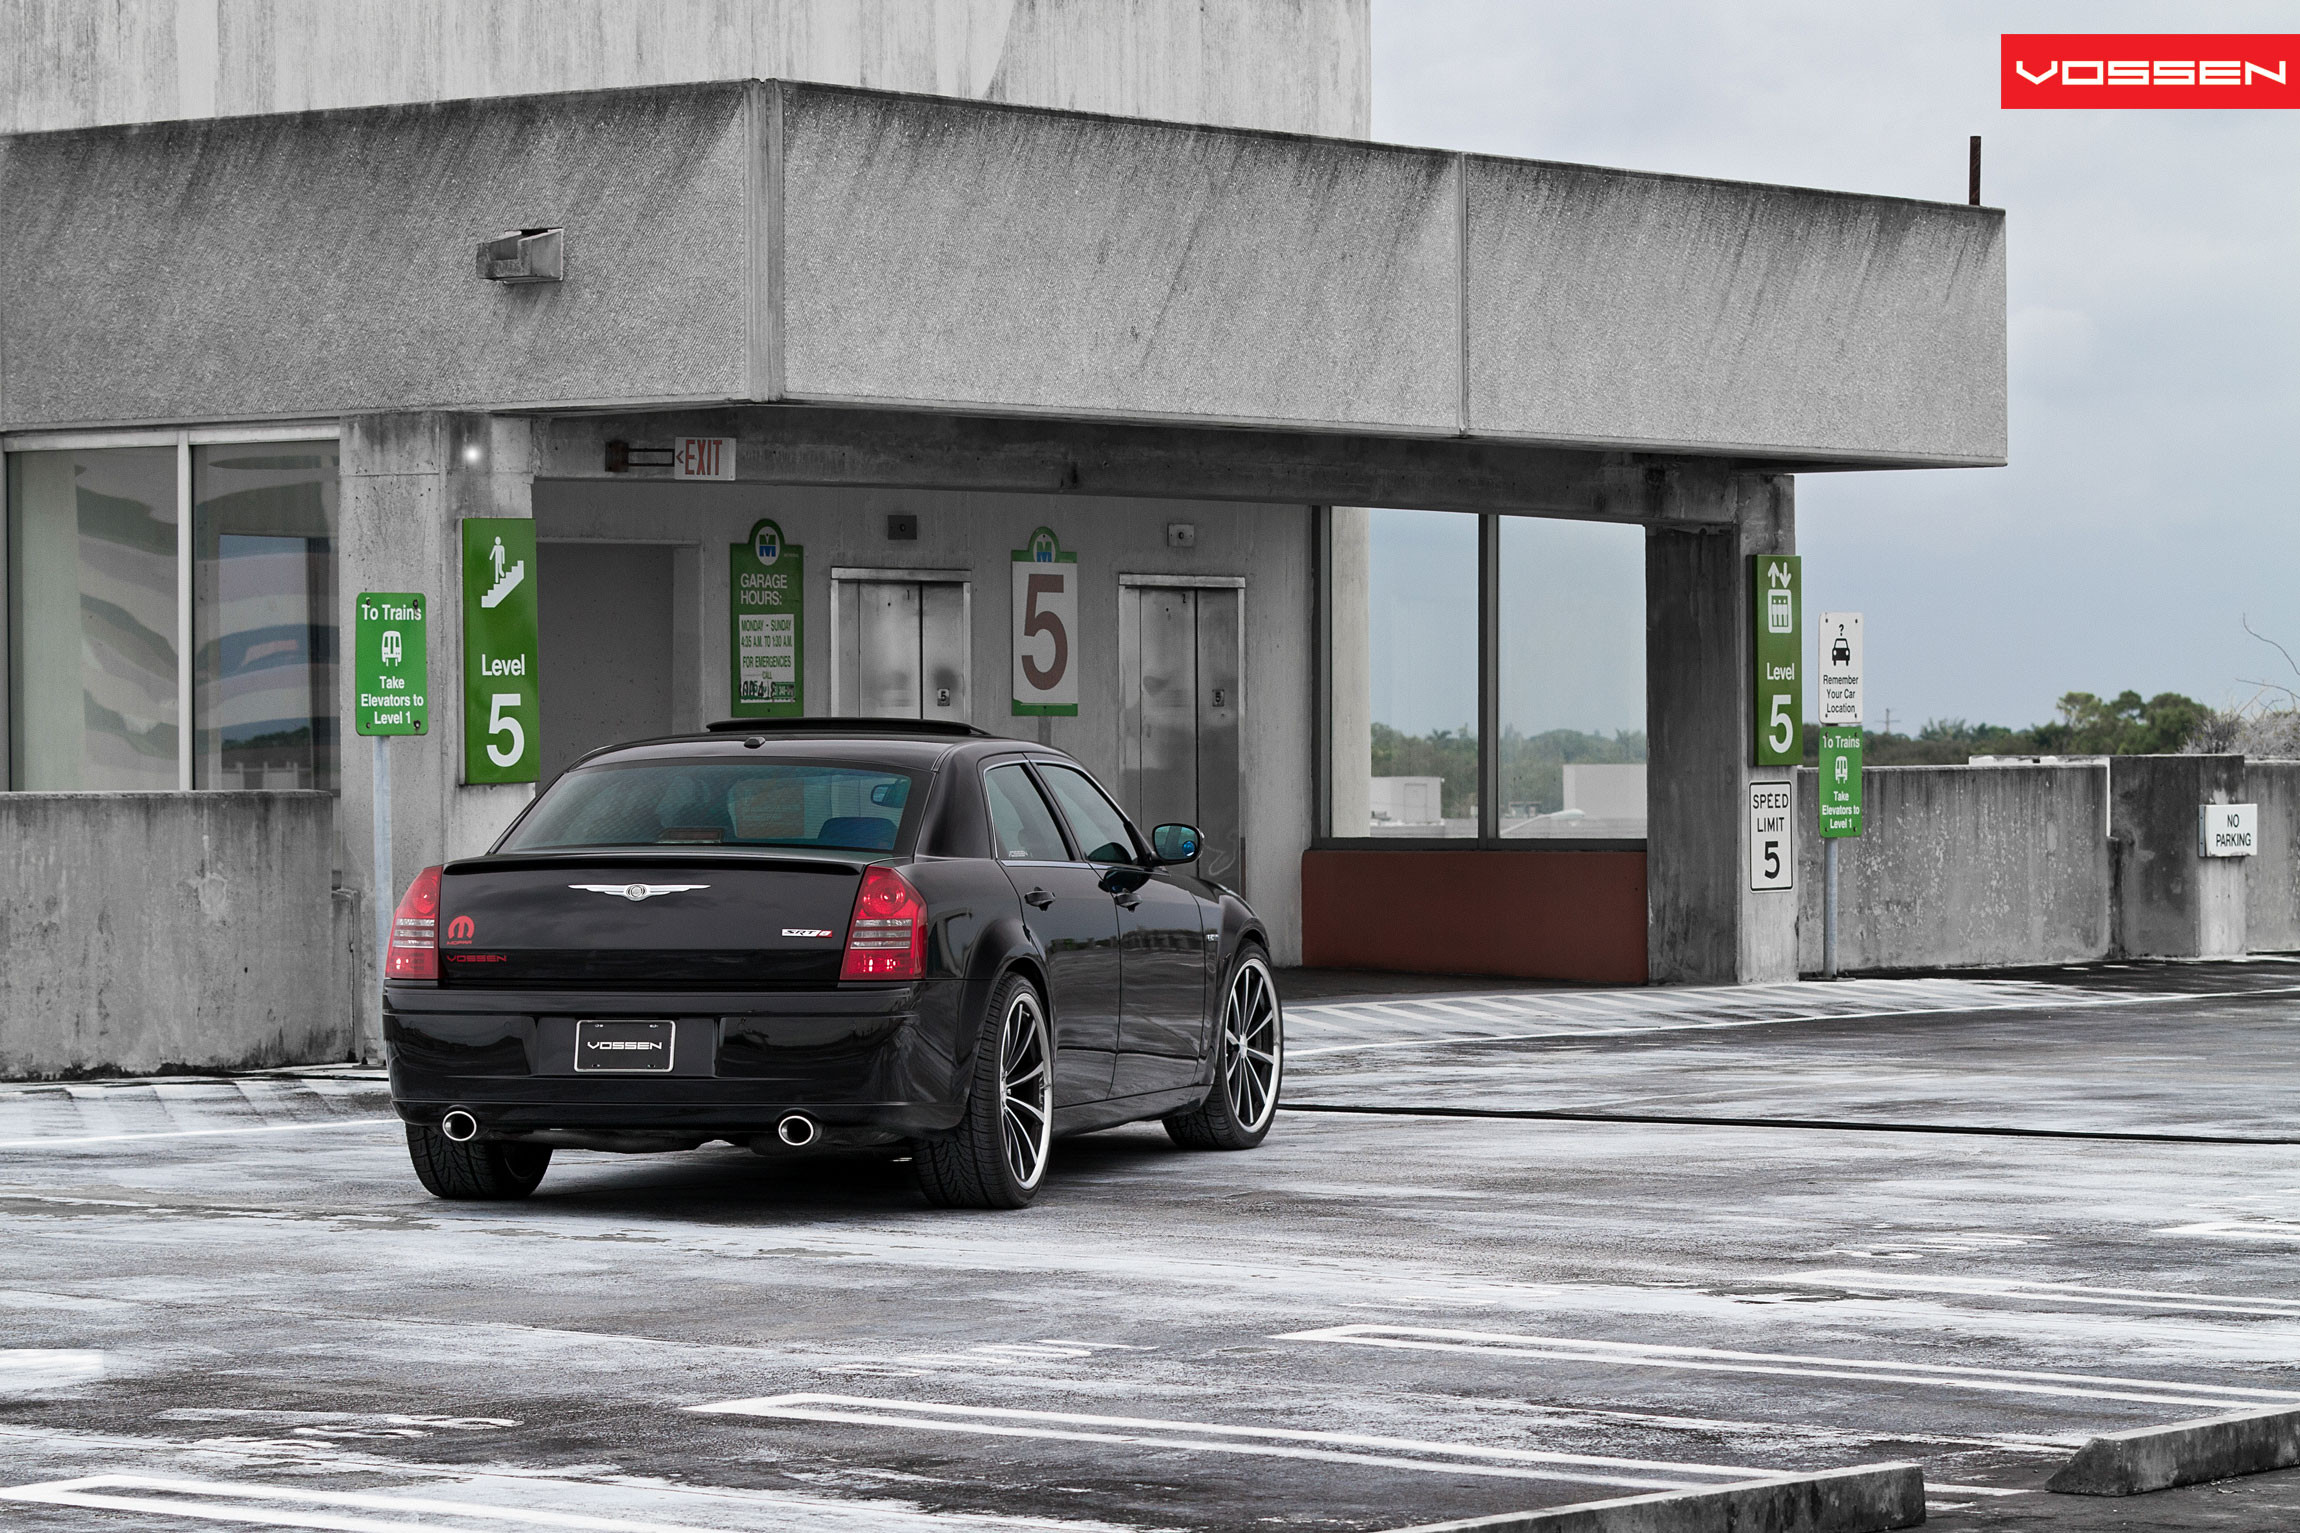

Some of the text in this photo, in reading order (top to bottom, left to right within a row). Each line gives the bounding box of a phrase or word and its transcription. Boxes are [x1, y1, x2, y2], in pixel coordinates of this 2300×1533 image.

[685, 440, 722, 475] EXIT
[740, 573, 787, 588] GARAGE
[740, 590, 782, 605] HOURS:
[361, 603, 422, 621] To Trains
[741, 620, 764, 631] MONDAY
[770, 620, 791, 631] SUNDAY
[1021, 573, 1068, 690] 5
[481, 653, 526, 676] Level
[743, 656, 791, 668] FOR EMERGENCIES
[1766, 662, 1795, 681] Level
[379, 676, 405, 689] Take
[1823, 674, 1859, 685] Remember
[361, 693, 424, 707] Elevators to
[1826, 688, 1855, 699] Your Car
[1826, 703, 1855, 714] Location
[374, 711, 411, 724] Level 1
[1769, 694, 1794, 753] 5
[486, 693, 525, 767] 5
[1835, 735, 1860, 748] Trains
[1752, 793, 1789, 809] SPEED
[1833, 791, 1849, 801] Take
[1822, 805, 1860, 816] Elevators to
[1757, 817, 1784, 833] LIMIT
[1830, 818, 1852, 829] Level 1
[2227, 814, 2240, 828] NO
[2216, 833, 2251, 847] PARKING
[1764, 840, 1780, 879] 5
[587, 1041, 662, 1050] VOSSEN
